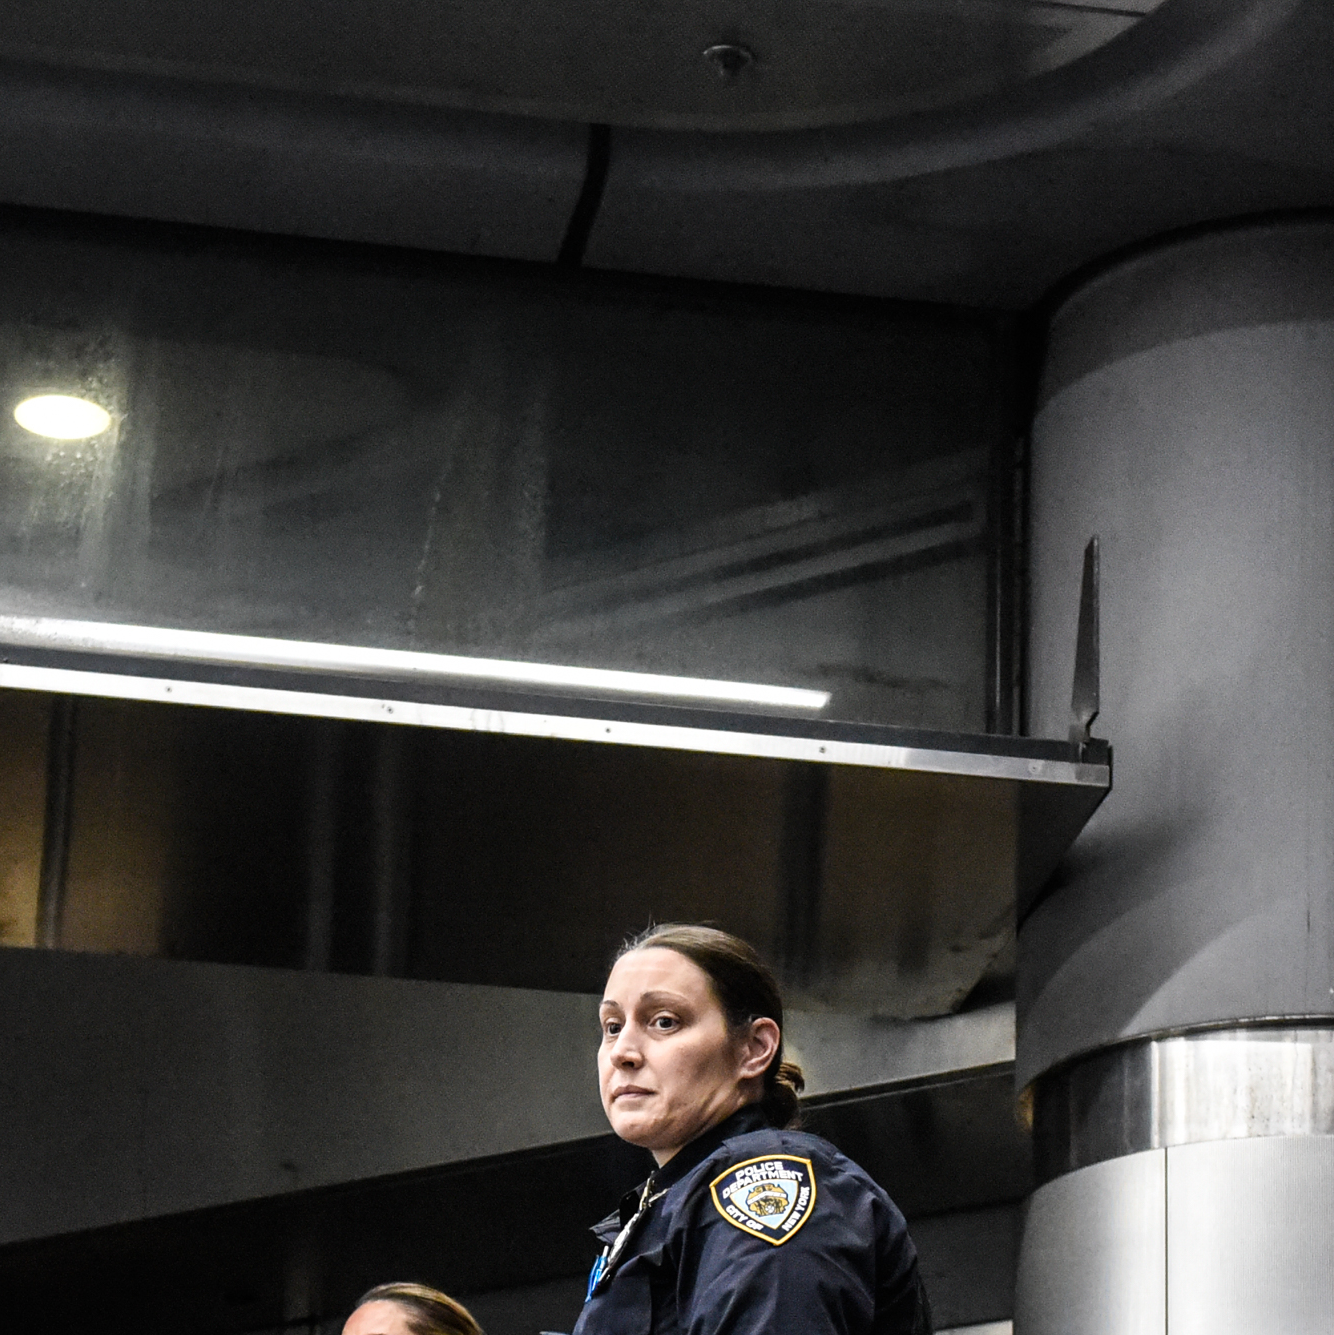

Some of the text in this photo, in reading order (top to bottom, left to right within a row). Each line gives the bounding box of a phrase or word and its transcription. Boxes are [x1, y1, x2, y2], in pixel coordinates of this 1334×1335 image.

[722, 1169, 804, 1199] DEPARTMENT
[735, 1161, 784, 1180] POLICE
[726, 1204, 764, 1231] CITY OF
[781, 1186, 810, 1231] NEW YORK
